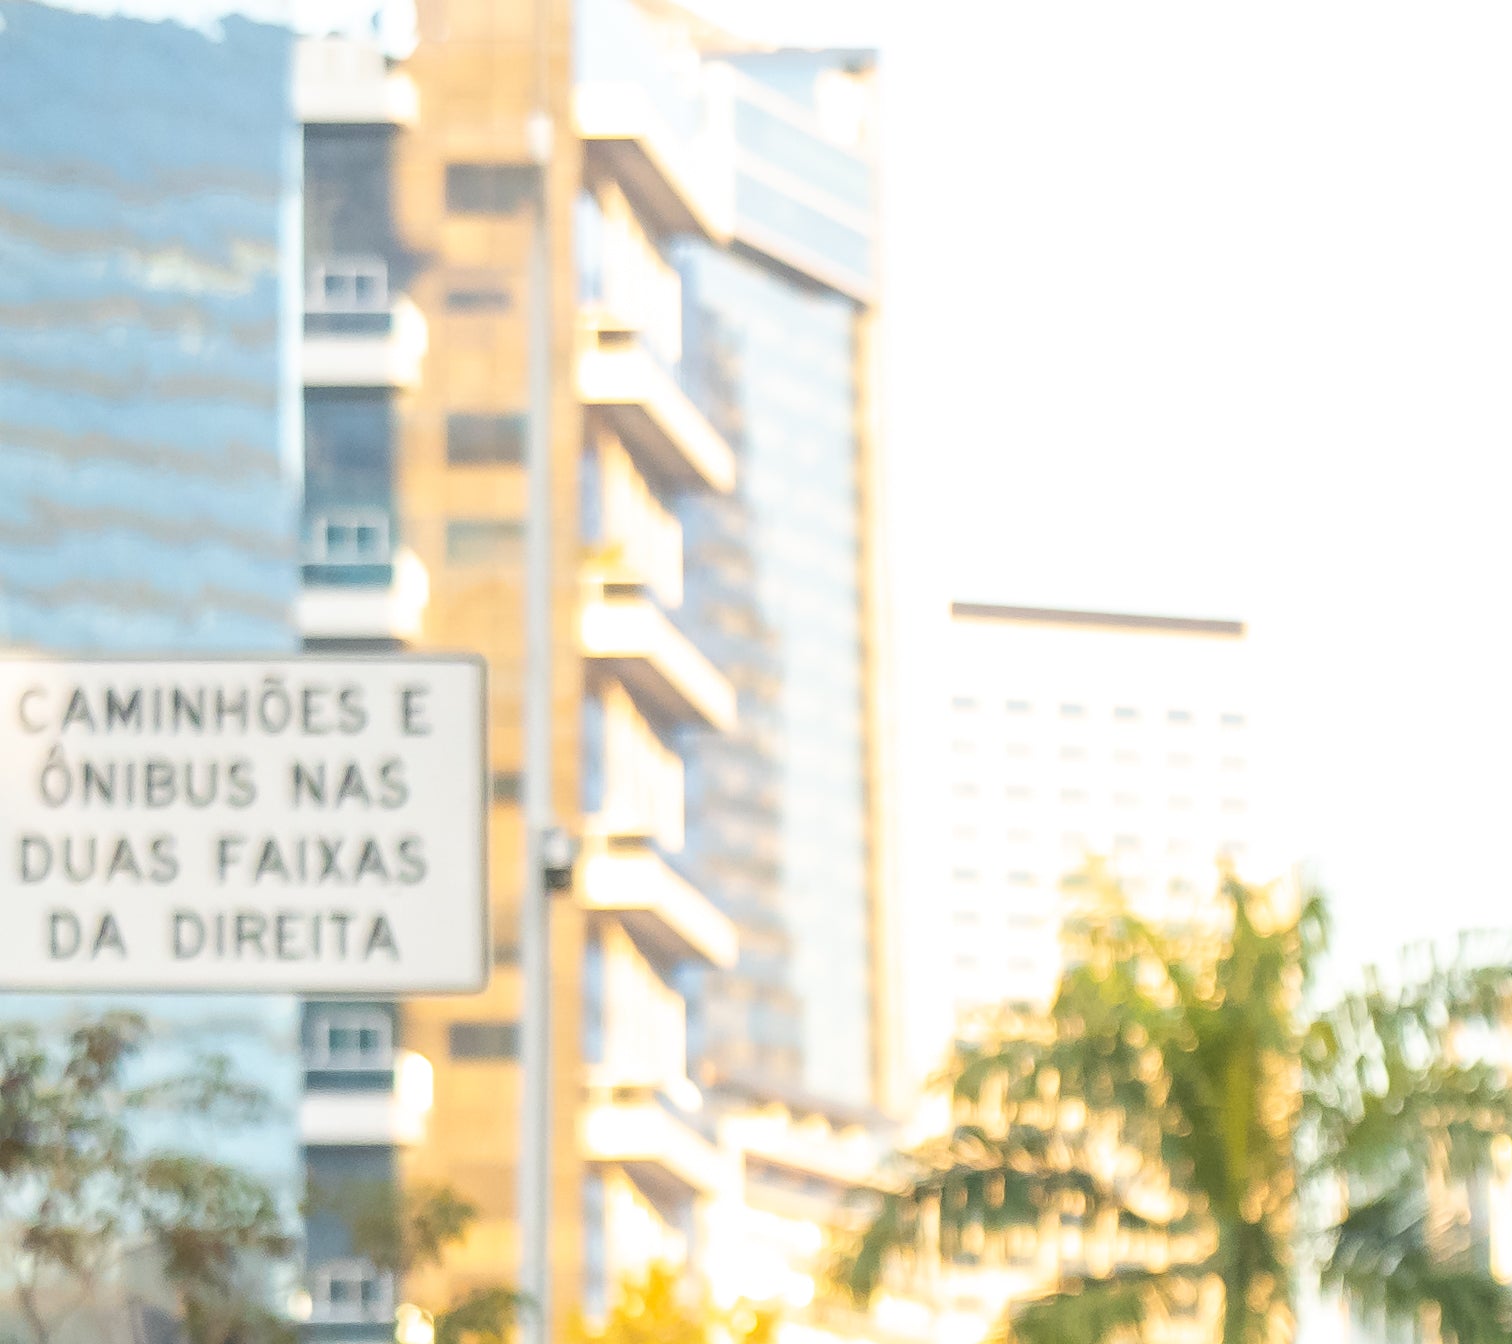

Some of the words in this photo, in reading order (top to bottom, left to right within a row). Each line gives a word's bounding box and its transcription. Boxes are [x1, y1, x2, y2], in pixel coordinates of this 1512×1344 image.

[19, 674, 369, 738] CAMINHÕES
[401, 686, 432, 738] E
[39, 743, 259, 809] ÔNIBUS
[291, 757, 411, 809] NAS
[18, 835, 181, 885] DUAS
[216, 835, 429, 886] FAIXAS
[48, 911, 128, 962] DA
[172, 910, 401, 962] DIREITA
